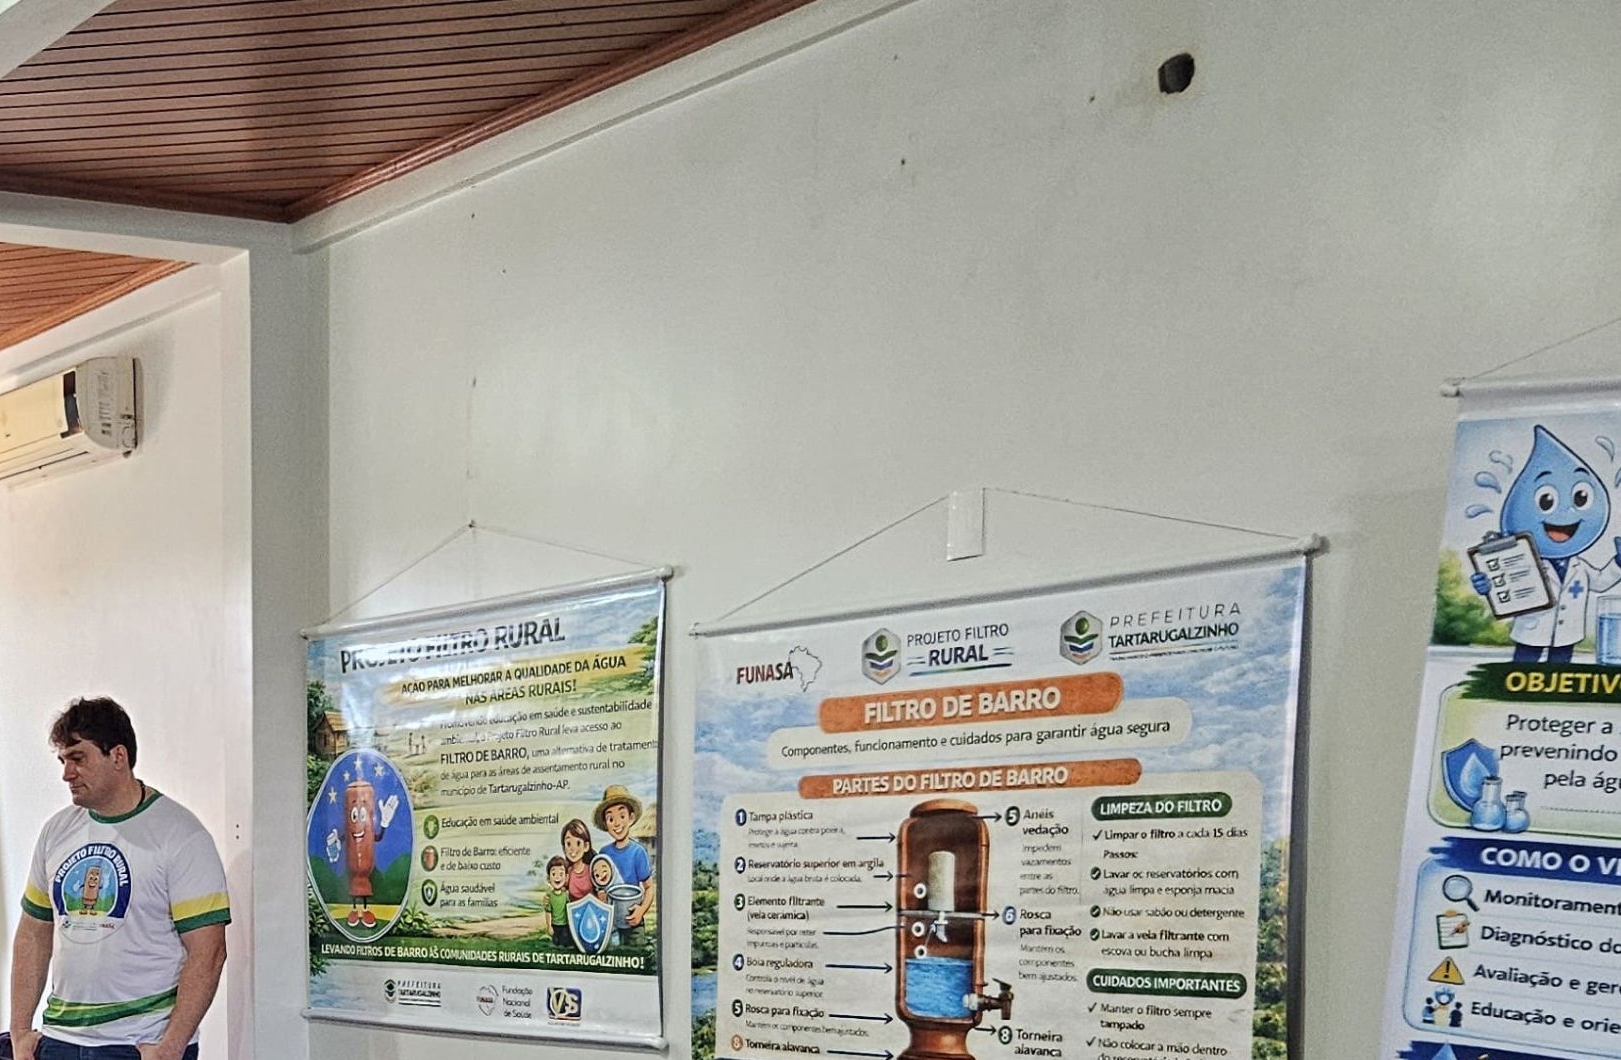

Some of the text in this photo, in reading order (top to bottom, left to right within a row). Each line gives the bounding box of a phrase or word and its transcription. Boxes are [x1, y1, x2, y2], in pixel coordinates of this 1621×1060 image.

[1110, 602, 1241, 628] PREFEITURA
[494, 617, 566, 650] RURAL
[907, 623, 1009, 647] PROJETO FILTRO
[1108, 622, 1240, 648] TARTARUGALZINHO
[928, 644, 989, 667] RURAL
[427, 678, 450, 691] PARA
[452, 671, 502, 688] MELHORAR
[505, 669, 512, 681] A
[514, 662, 571, 680] QUALIDADE
[575, 659, 589, 672] DA
[593, 654, 627, 670] ÁGUA
[736, 661, 794, 684] FUNASA
[529, 680, 577, 697] RURAIS!
[1505, 671, 1621, 694] OBJETIV
[864, 682, 1062, 725] FILTRO DE BARRO
[1506, 714, 1613, 737] Proteger a
[781, 721, 1171, 762] Componentes, funcionamento e cuidados para garantir água segura
[441, 743, 607, 764] FILTRO DE BARRO, de
[1500, 744, 1618, 762] prevenindo
[832, 766, 1069, 794] PARTES DO FILTRO DE BARRO
[1544, 770, 1586, 789] pela
[1101, 799, 1222, 815] LIMPEZA DO FILTRO
[442, 814, 559, 829] Educação em saúde ambiental
[749, 812, 777, 823] Tampa
[1008, 809, 1054, 823] 5 Anéis
[1022, 825, 1069, 838] vedação
[1105, 829, 1138, 841] Limpar
[1150, 829, 1175, 839] filtro
[1186, 828, 1209, 838] cada
[1213, 828, 1223, 837] 15
[1227, 827, 1248, 837] dias
[1103, 850, 1138, 859] Passos:
[1481, 847, 1562, 871] COMO
[1569, 855, 1590, 872] O
[55, 848, 87, 883] PROJETO
[112, 854, 129, 887] RURAL
[737, 860, 744, 871] 2
[749, 859, 801, 869] Reservatório
[803, 858, 840, 869] superior
[859, 858, 884, 871] argila
[440, 881, 459, 894] Água
[748, 896, 786, 906] Elemento
[789, 896, 825, 906] filtrante
[1020, 909, 1051, 919] Rosca
[1020, 925, 1082, 939] para fixação
[1102, 930, 1126, 939] Lavar
[1137, 931, 1157, 939] vela
[1160, 930, 1205, 941] filtrante
[1207, 933, 1229, 942] com
[1481, 926, 1593, 951] Diagnóstico
[321, 944, 355, 954] LEVANDO
[356, 945, 383, 956] FILTROS
[384, 946, 396, 956] DE
[398, 948, 427, 958] BARRO
[440, 949, 497, 962] COMUNIDADES
[499, 952, 530, 962] RURAIS
[533, 953, 544, 963] DE
[546, 953, 644, 969] TARTARUGALZINHO!
[1150, 947, 1180, 957] bucha
[1184, 948, 1213, 960] limpa
[766, 958, 813, 970] reguladora
[1093, 975, 1241, 992] CUIDADOS IMPORTANTES
[1474, 964, 1621, 995] Avaliação e ger
[745, 1004, 769, 1014] Rosca
[771, 1008, 790, 1016] para
[793, 1006, 824, 1019] fixação
[1100, 1004, 1134, 1014] Manter
[1146, 1005, 1171, 1016] filtro
[1173, 1008, 1212, 1020] sempre
[1471, 1001, 1556, 1025] Educação
[1563, 1016, 1575, 1027] e
[1100, 1020, 1145, 1031] tampado
[1016, 1029, 1063, 1042] Torneira
[782, 1042, 820, 1054] alavanca
[1014, 1044, 1062, 1057] alavanca
[1098, 1038, 1118, 1048] Não
[1120, 1040, 1154, 1050] colocar
[1167, 1043, 1190, 1053] mão
[1192, 1044, 1227, 1056] dentro
